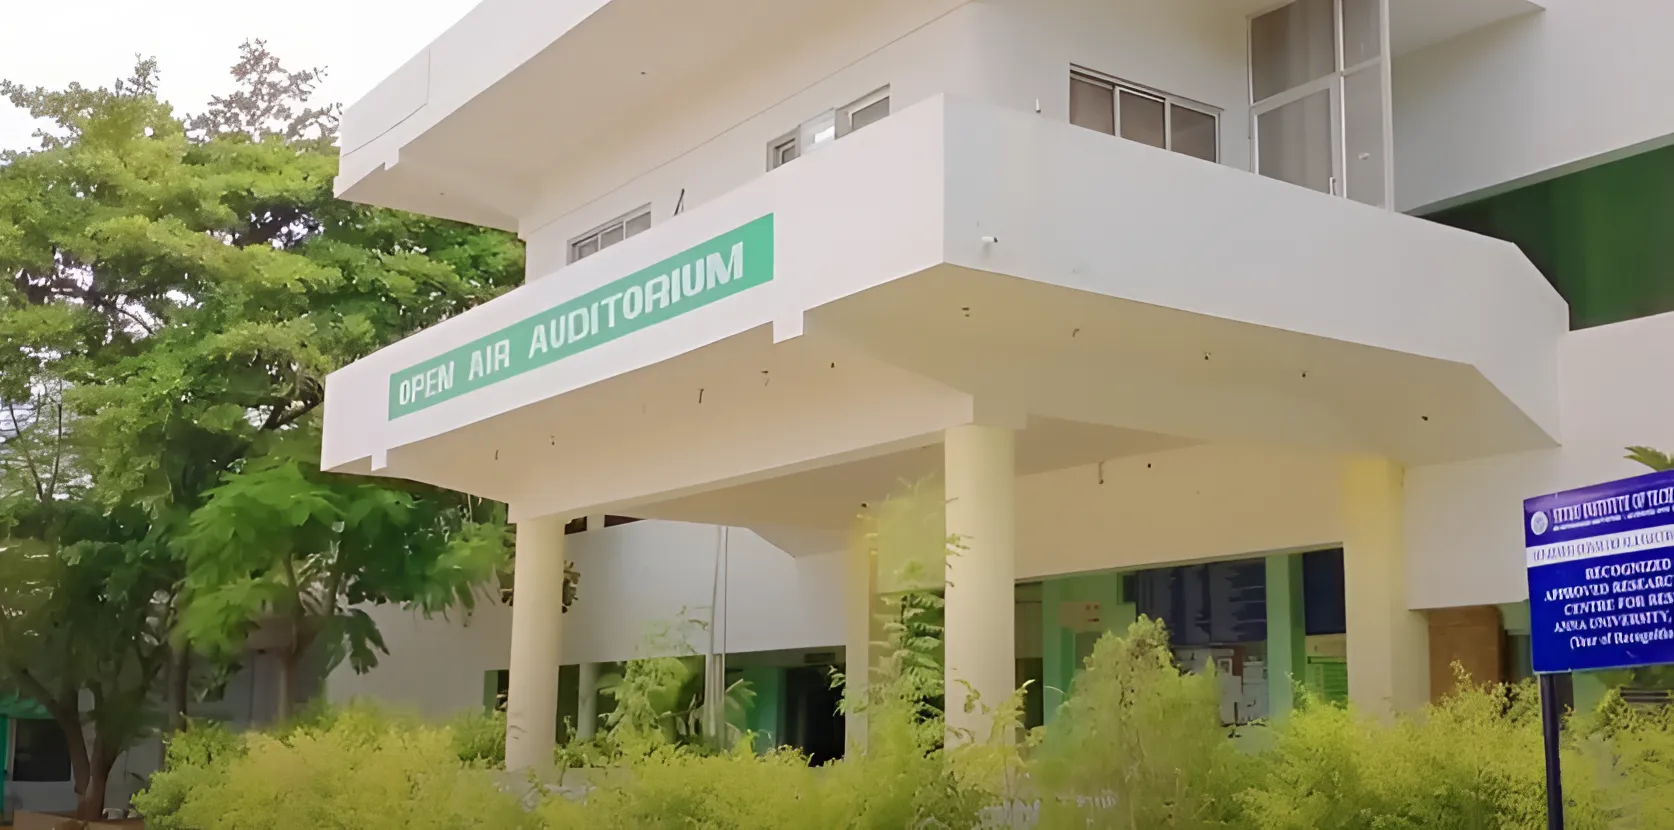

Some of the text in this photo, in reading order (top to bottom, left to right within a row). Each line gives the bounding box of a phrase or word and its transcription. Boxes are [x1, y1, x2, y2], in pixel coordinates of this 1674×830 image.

[400, 241, 743, 405] OPEN AIR AUDITORIUM
[1585, 558, 1671, 580] RECOGNIZED
[1545, 574, 1674, 602] APPROVED RESEARC
[1564, 591, 1674, 615] CENTRE FOR RES
[1554, 620, 1587, 633] ANNA
[1599, 632, 1611, 645] of
